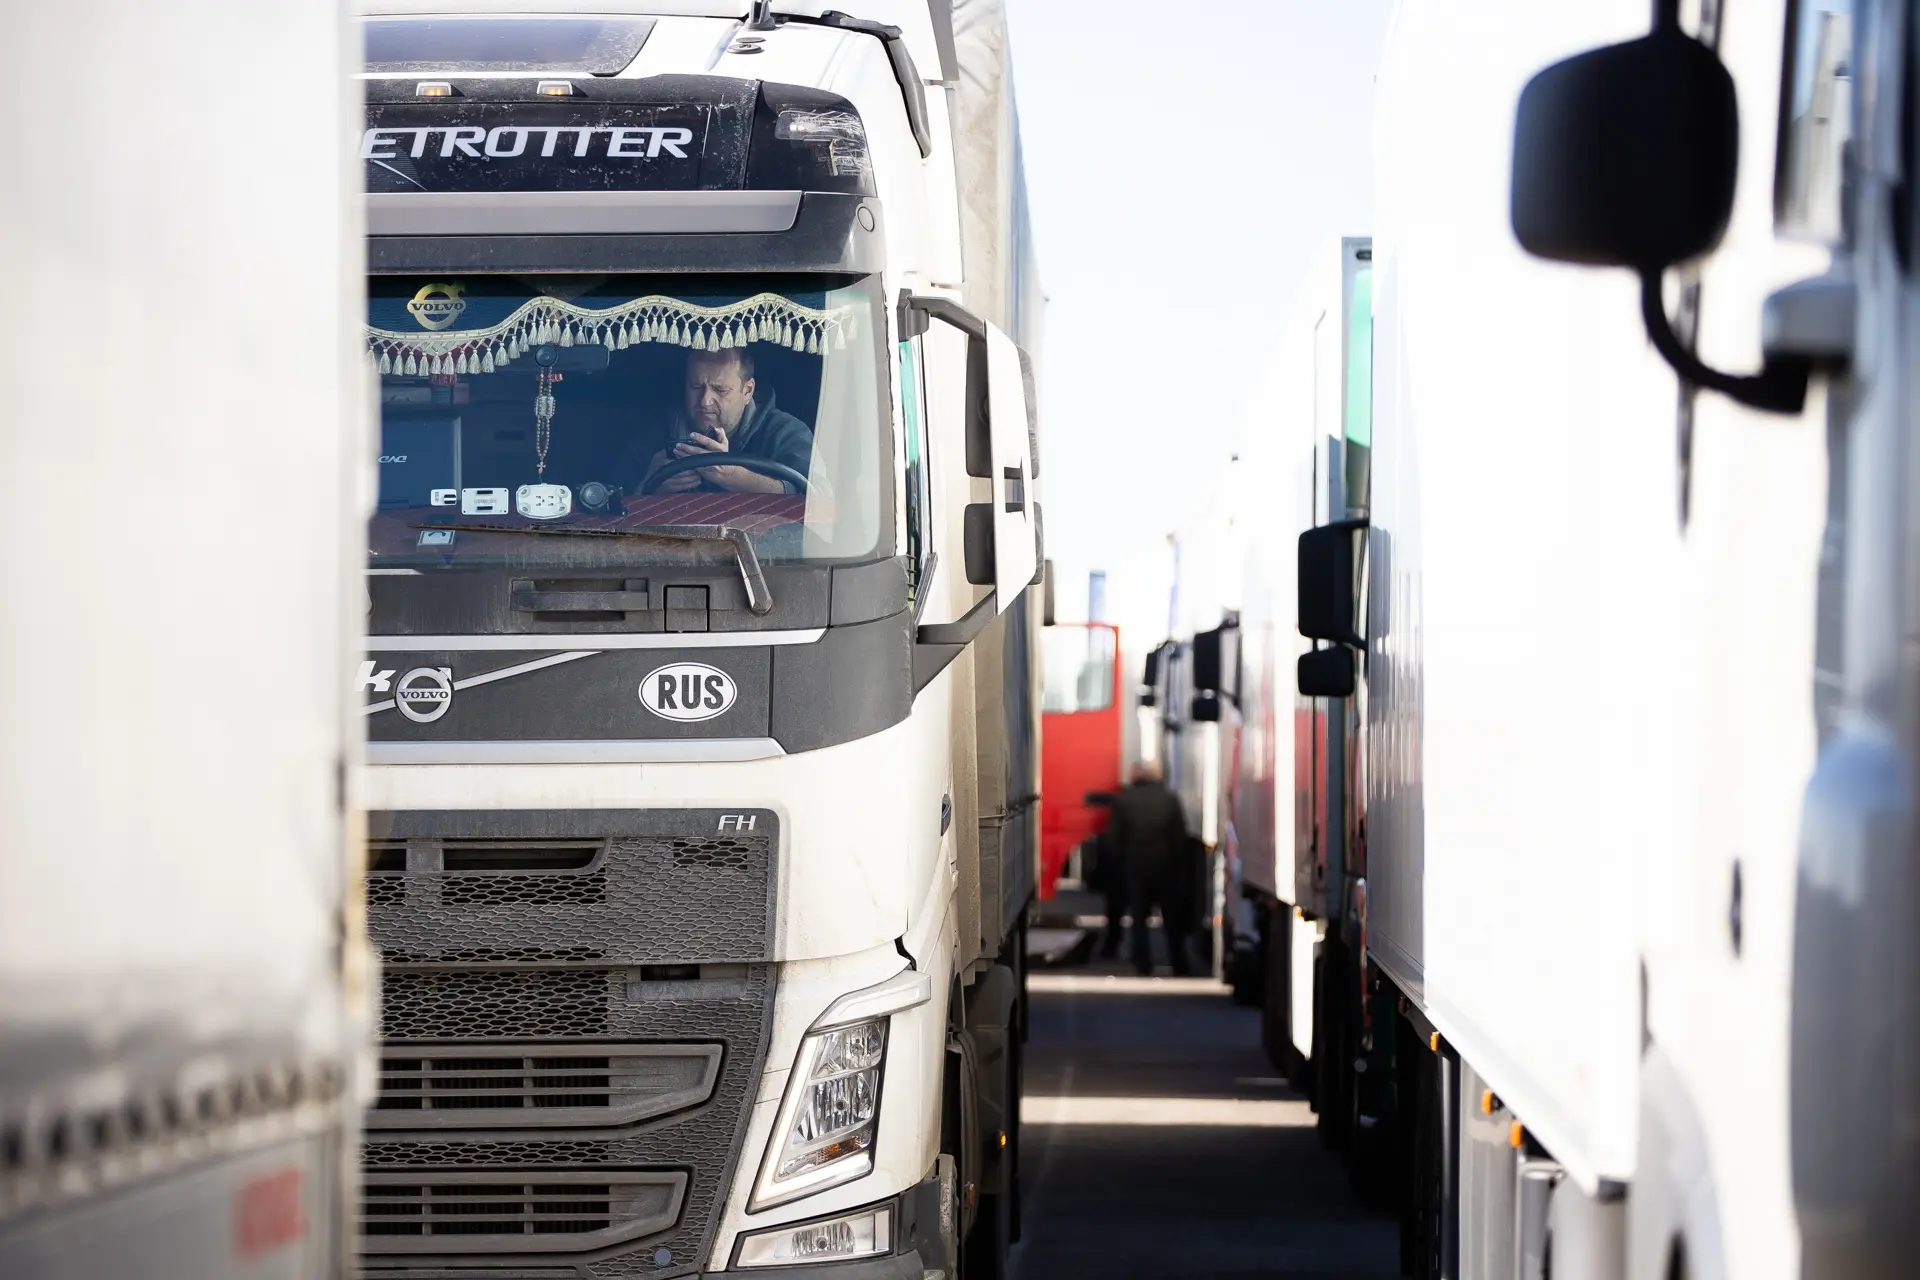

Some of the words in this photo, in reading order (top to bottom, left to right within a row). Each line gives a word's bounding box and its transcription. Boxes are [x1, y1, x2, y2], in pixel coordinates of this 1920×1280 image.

[411, 303, 464, 311] VOLVO
[399, 691, 449, 699] VOLVO
[658, 674, 724, 710] RUS
[717, 814, 757, 831] FH
